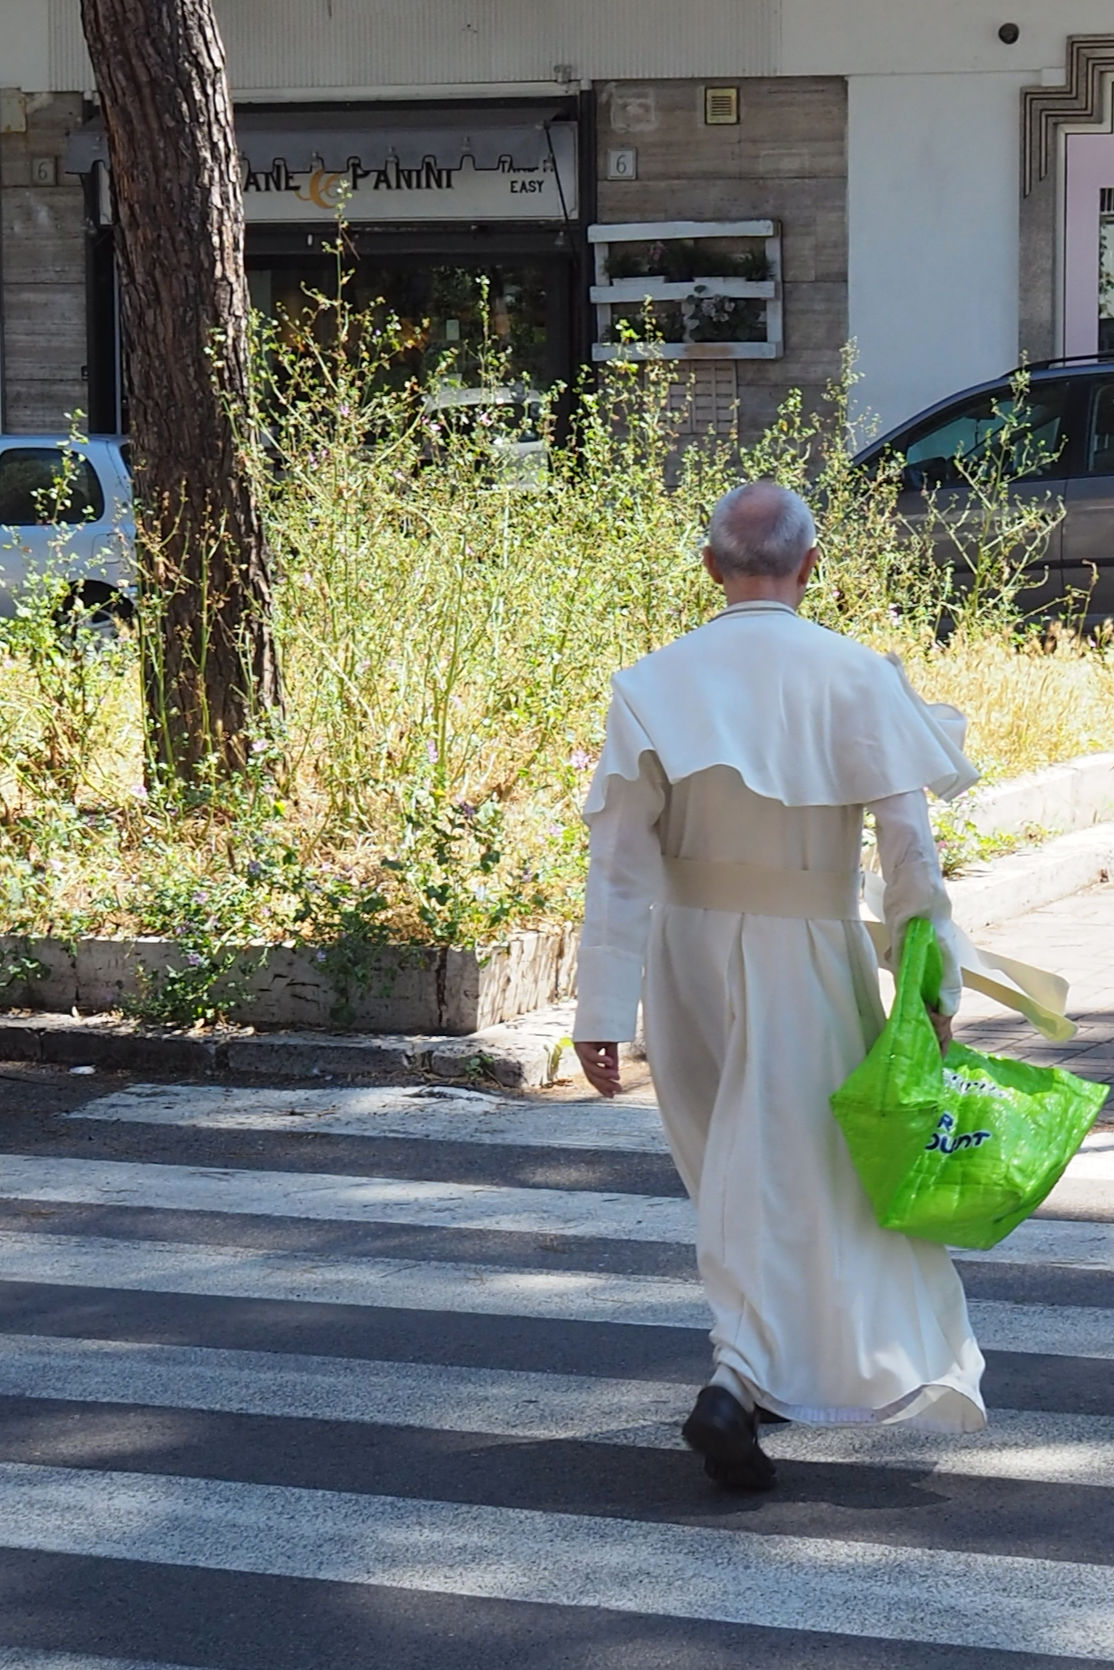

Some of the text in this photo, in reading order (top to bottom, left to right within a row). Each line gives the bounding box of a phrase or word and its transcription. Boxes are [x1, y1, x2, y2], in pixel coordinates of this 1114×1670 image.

[38, 161, 48, 180] 6
[616, 154, 627, 174] 6
[243, 163, 301, 192] ANE
[350, 161, 454, 190] PANINI
[510, 180, 544, 193] EASY
